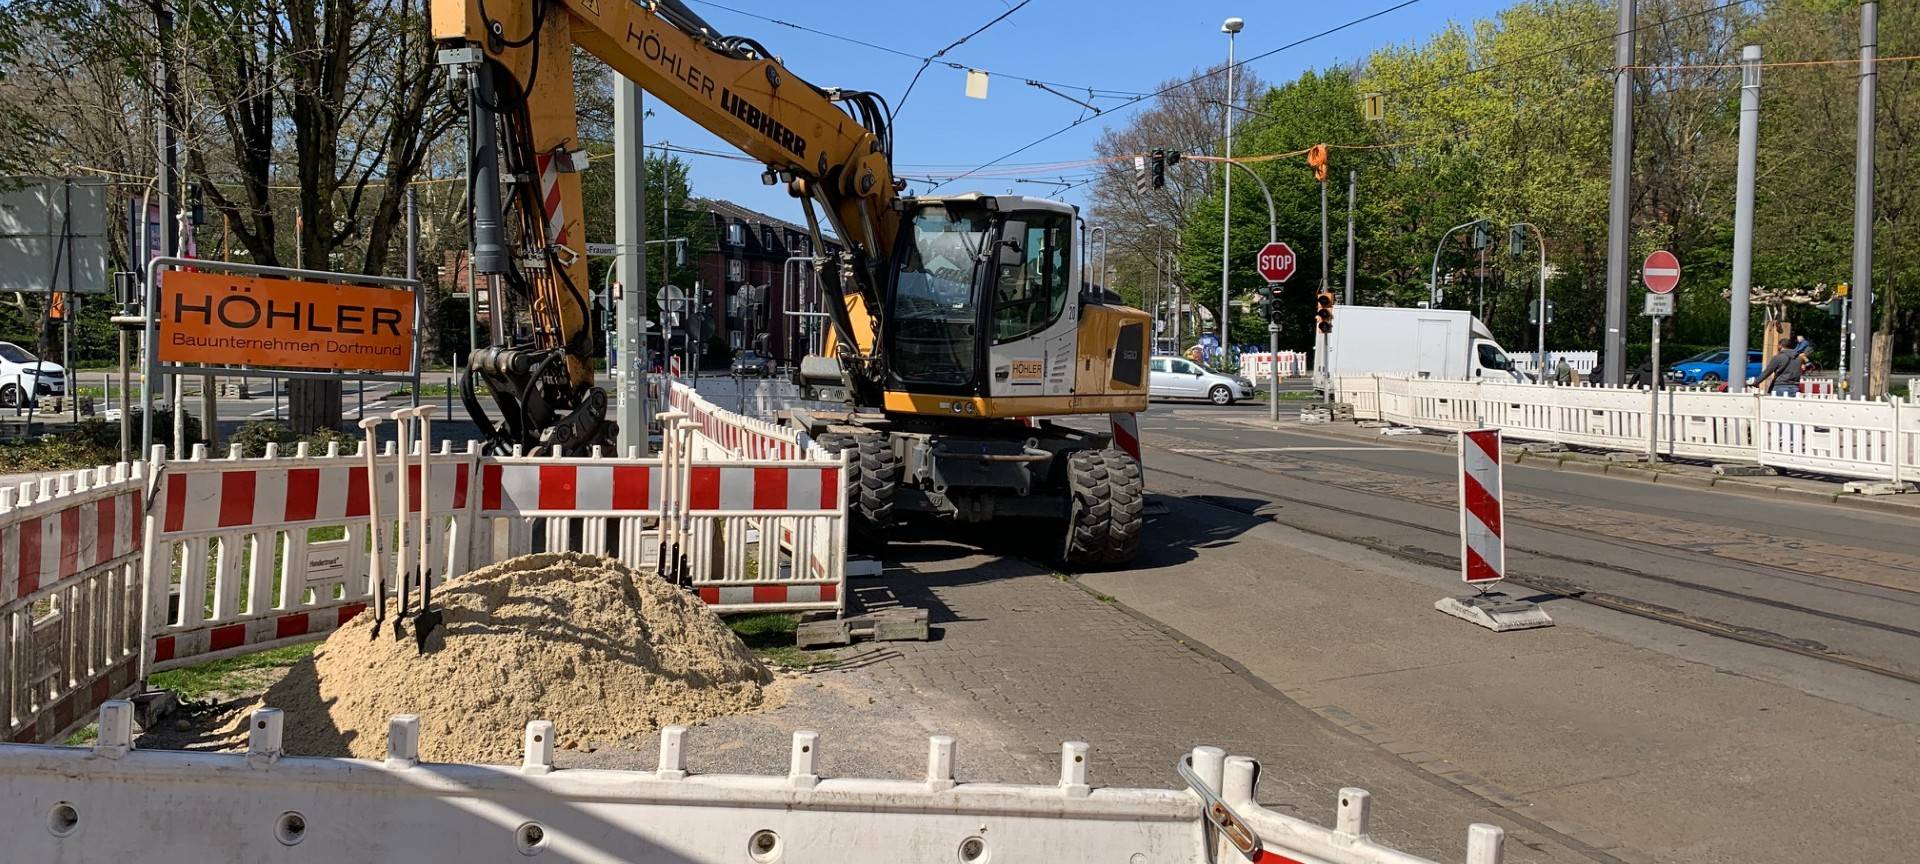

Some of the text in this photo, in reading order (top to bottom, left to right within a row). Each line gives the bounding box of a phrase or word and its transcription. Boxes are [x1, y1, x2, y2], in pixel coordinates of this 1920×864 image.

[626, 22, 715, 100] HÖHLER
[1371, 96, 1377, 116] 1
[720, 87, 807, 159] LIEBHERR
[1261, 255, 1292, 270] STOP
[174, 285, 403, 336] HÖHLER
[172, 332, 402, 356] Bauunternehmen Dortmund
[1012, 360, 1042, 374] HÖHLER
